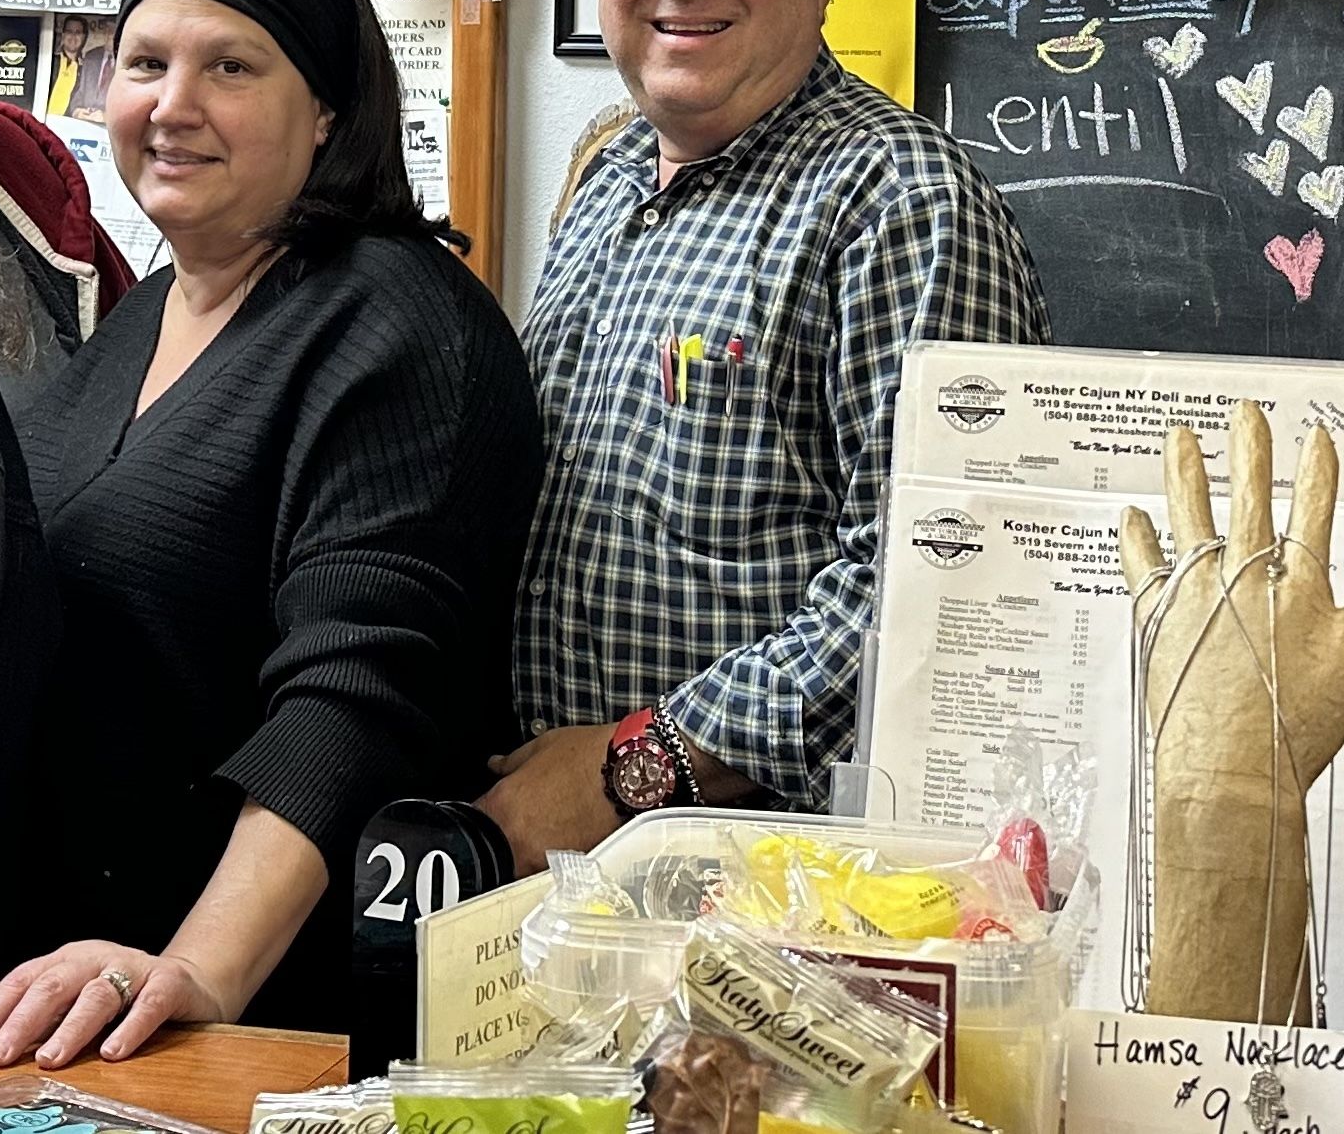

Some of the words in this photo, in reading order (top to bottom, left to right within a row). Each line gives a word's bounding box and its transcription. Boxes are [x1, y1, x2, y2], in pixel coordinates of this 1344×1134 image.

[944, 77, 1186, 172] Lentil
[1023, 383, 1075, 396] Kosher
[1080, 386, 1120, 399] Cajun
[1125, 389, 1147, 400] NY
[1151, 391, 1179, 403] Deli
[1185, 393, 1211, 404] and
[1064, 400, 1101, 411] Severn
[1169, 407, 1225, 419] Louisiana
[1076, 413, 1128, 424] 888-2010
[364, 841, 458, 921] 20
[1095, 1020, 1203, 1068] Hamsa
